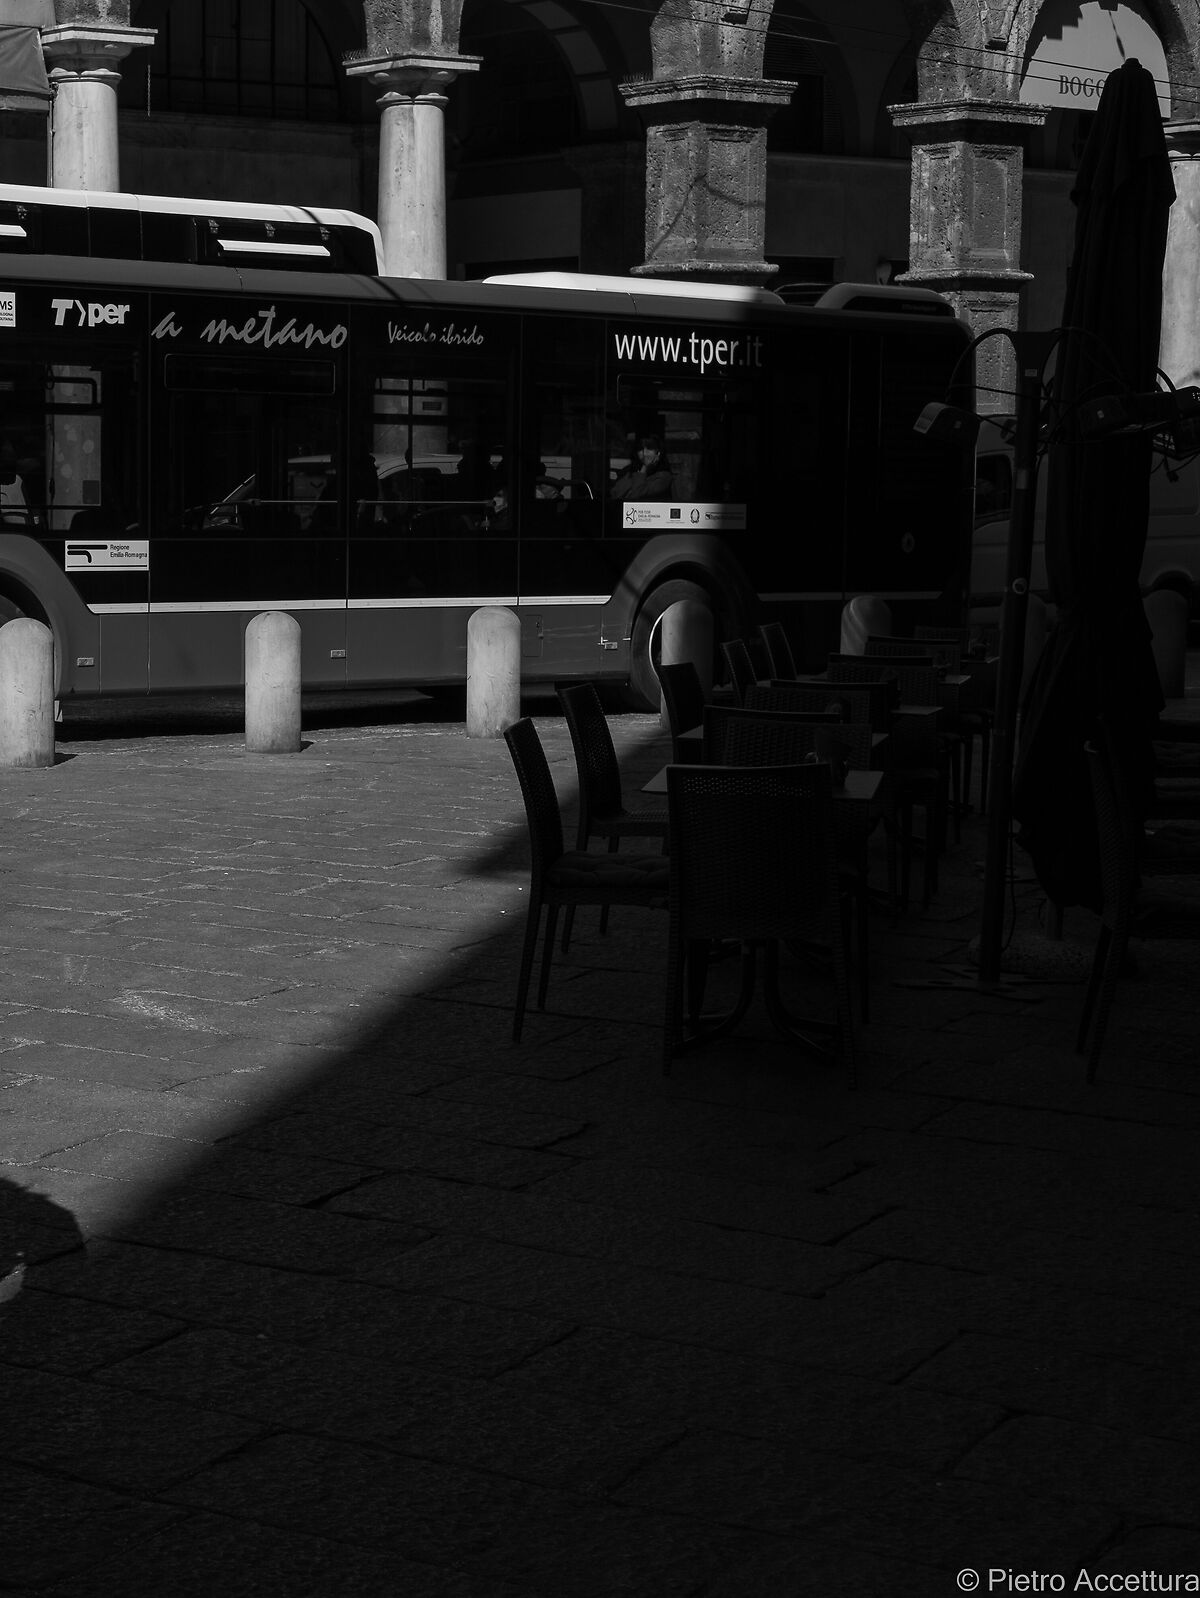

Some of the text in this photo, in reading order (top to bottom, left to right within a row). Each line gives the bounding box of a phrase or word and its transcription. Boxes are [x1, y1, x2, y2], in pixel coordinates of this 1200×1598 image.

[150, 304, 349, 349] a metano
[387, 319, 486, 346] Veicolo ibrido
[614, 331, 766, 375] www.tper.it
